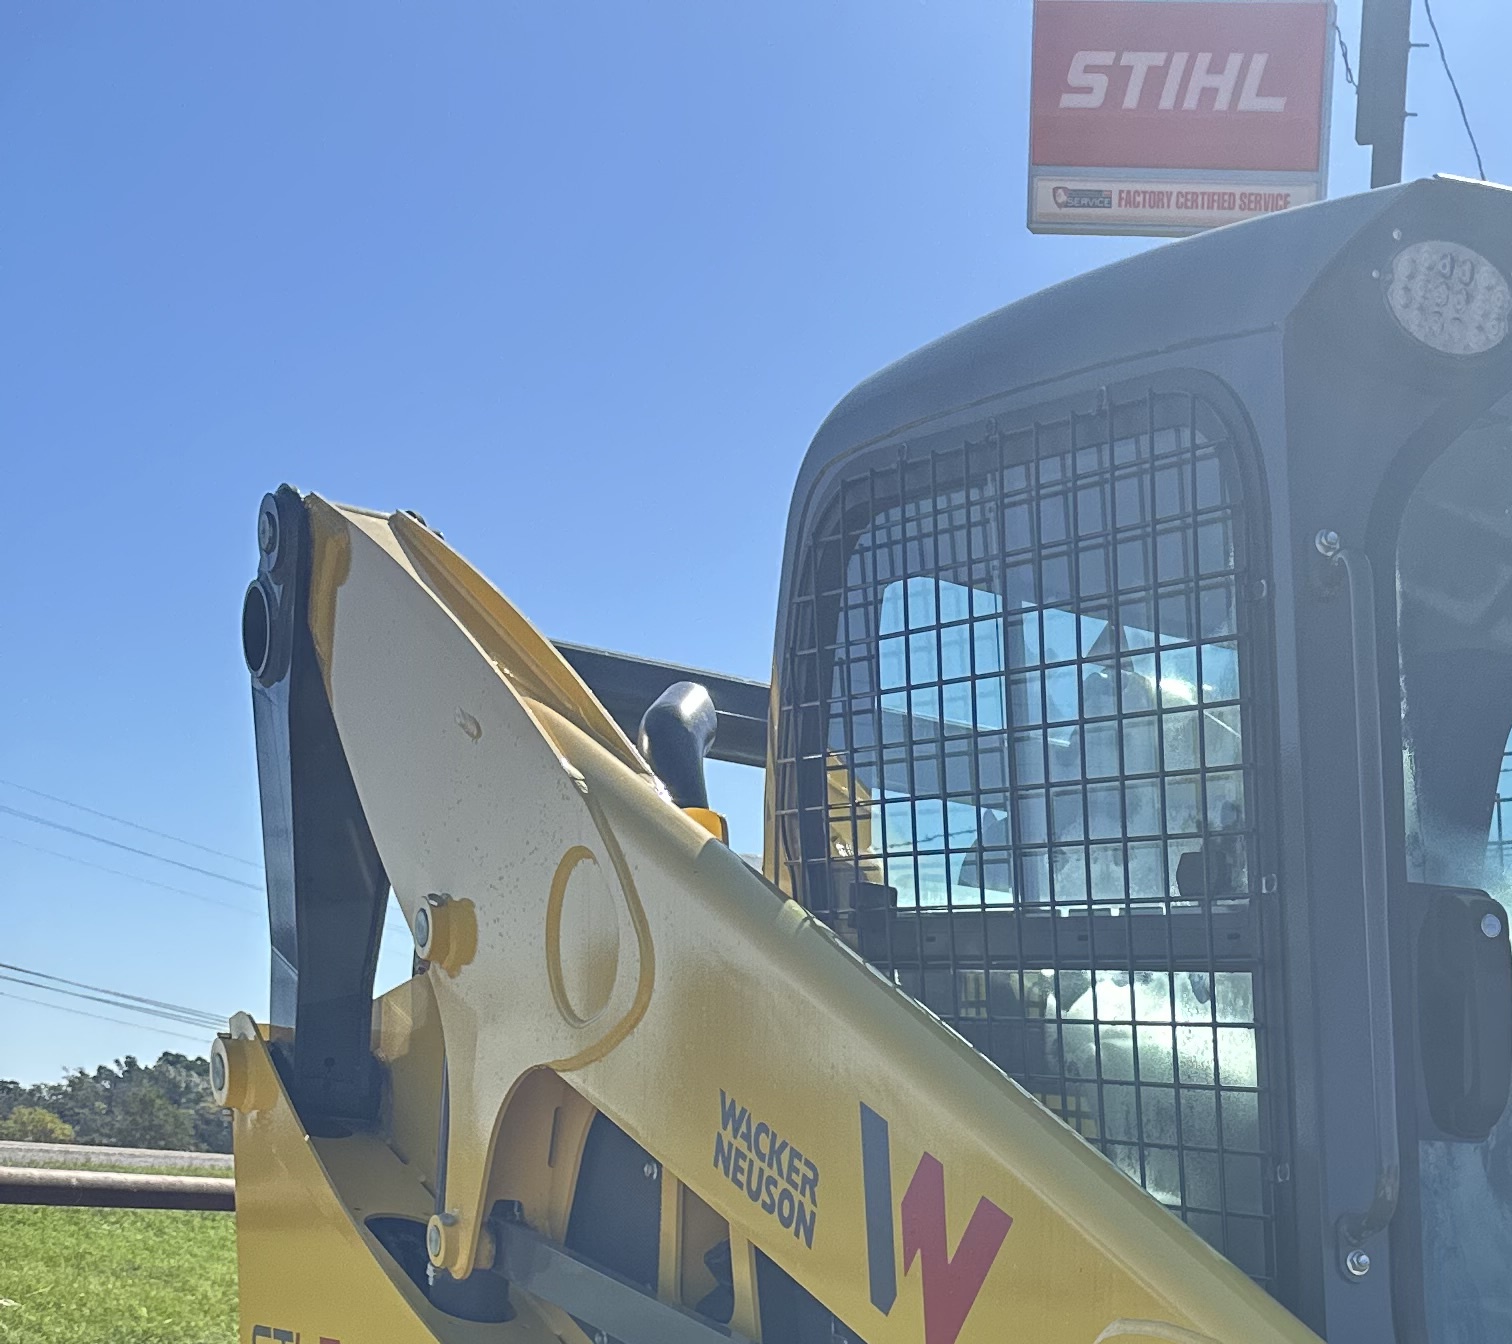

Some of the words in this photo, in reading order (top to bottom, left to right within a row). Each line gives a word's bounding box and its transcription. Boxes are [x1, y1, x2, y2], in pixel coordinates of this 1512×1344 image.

[1059, 50, 1287, 112] STIHL
[1117, 189, 1172, 209] FACTORY
[1175, 189, 1236, 211] CERTIFIED
[1238, 191, 1291, 212] SERVICE
[712, 1130, 817, 1251] NEUSON
[718, 1087, 820, 1209] WACKER
